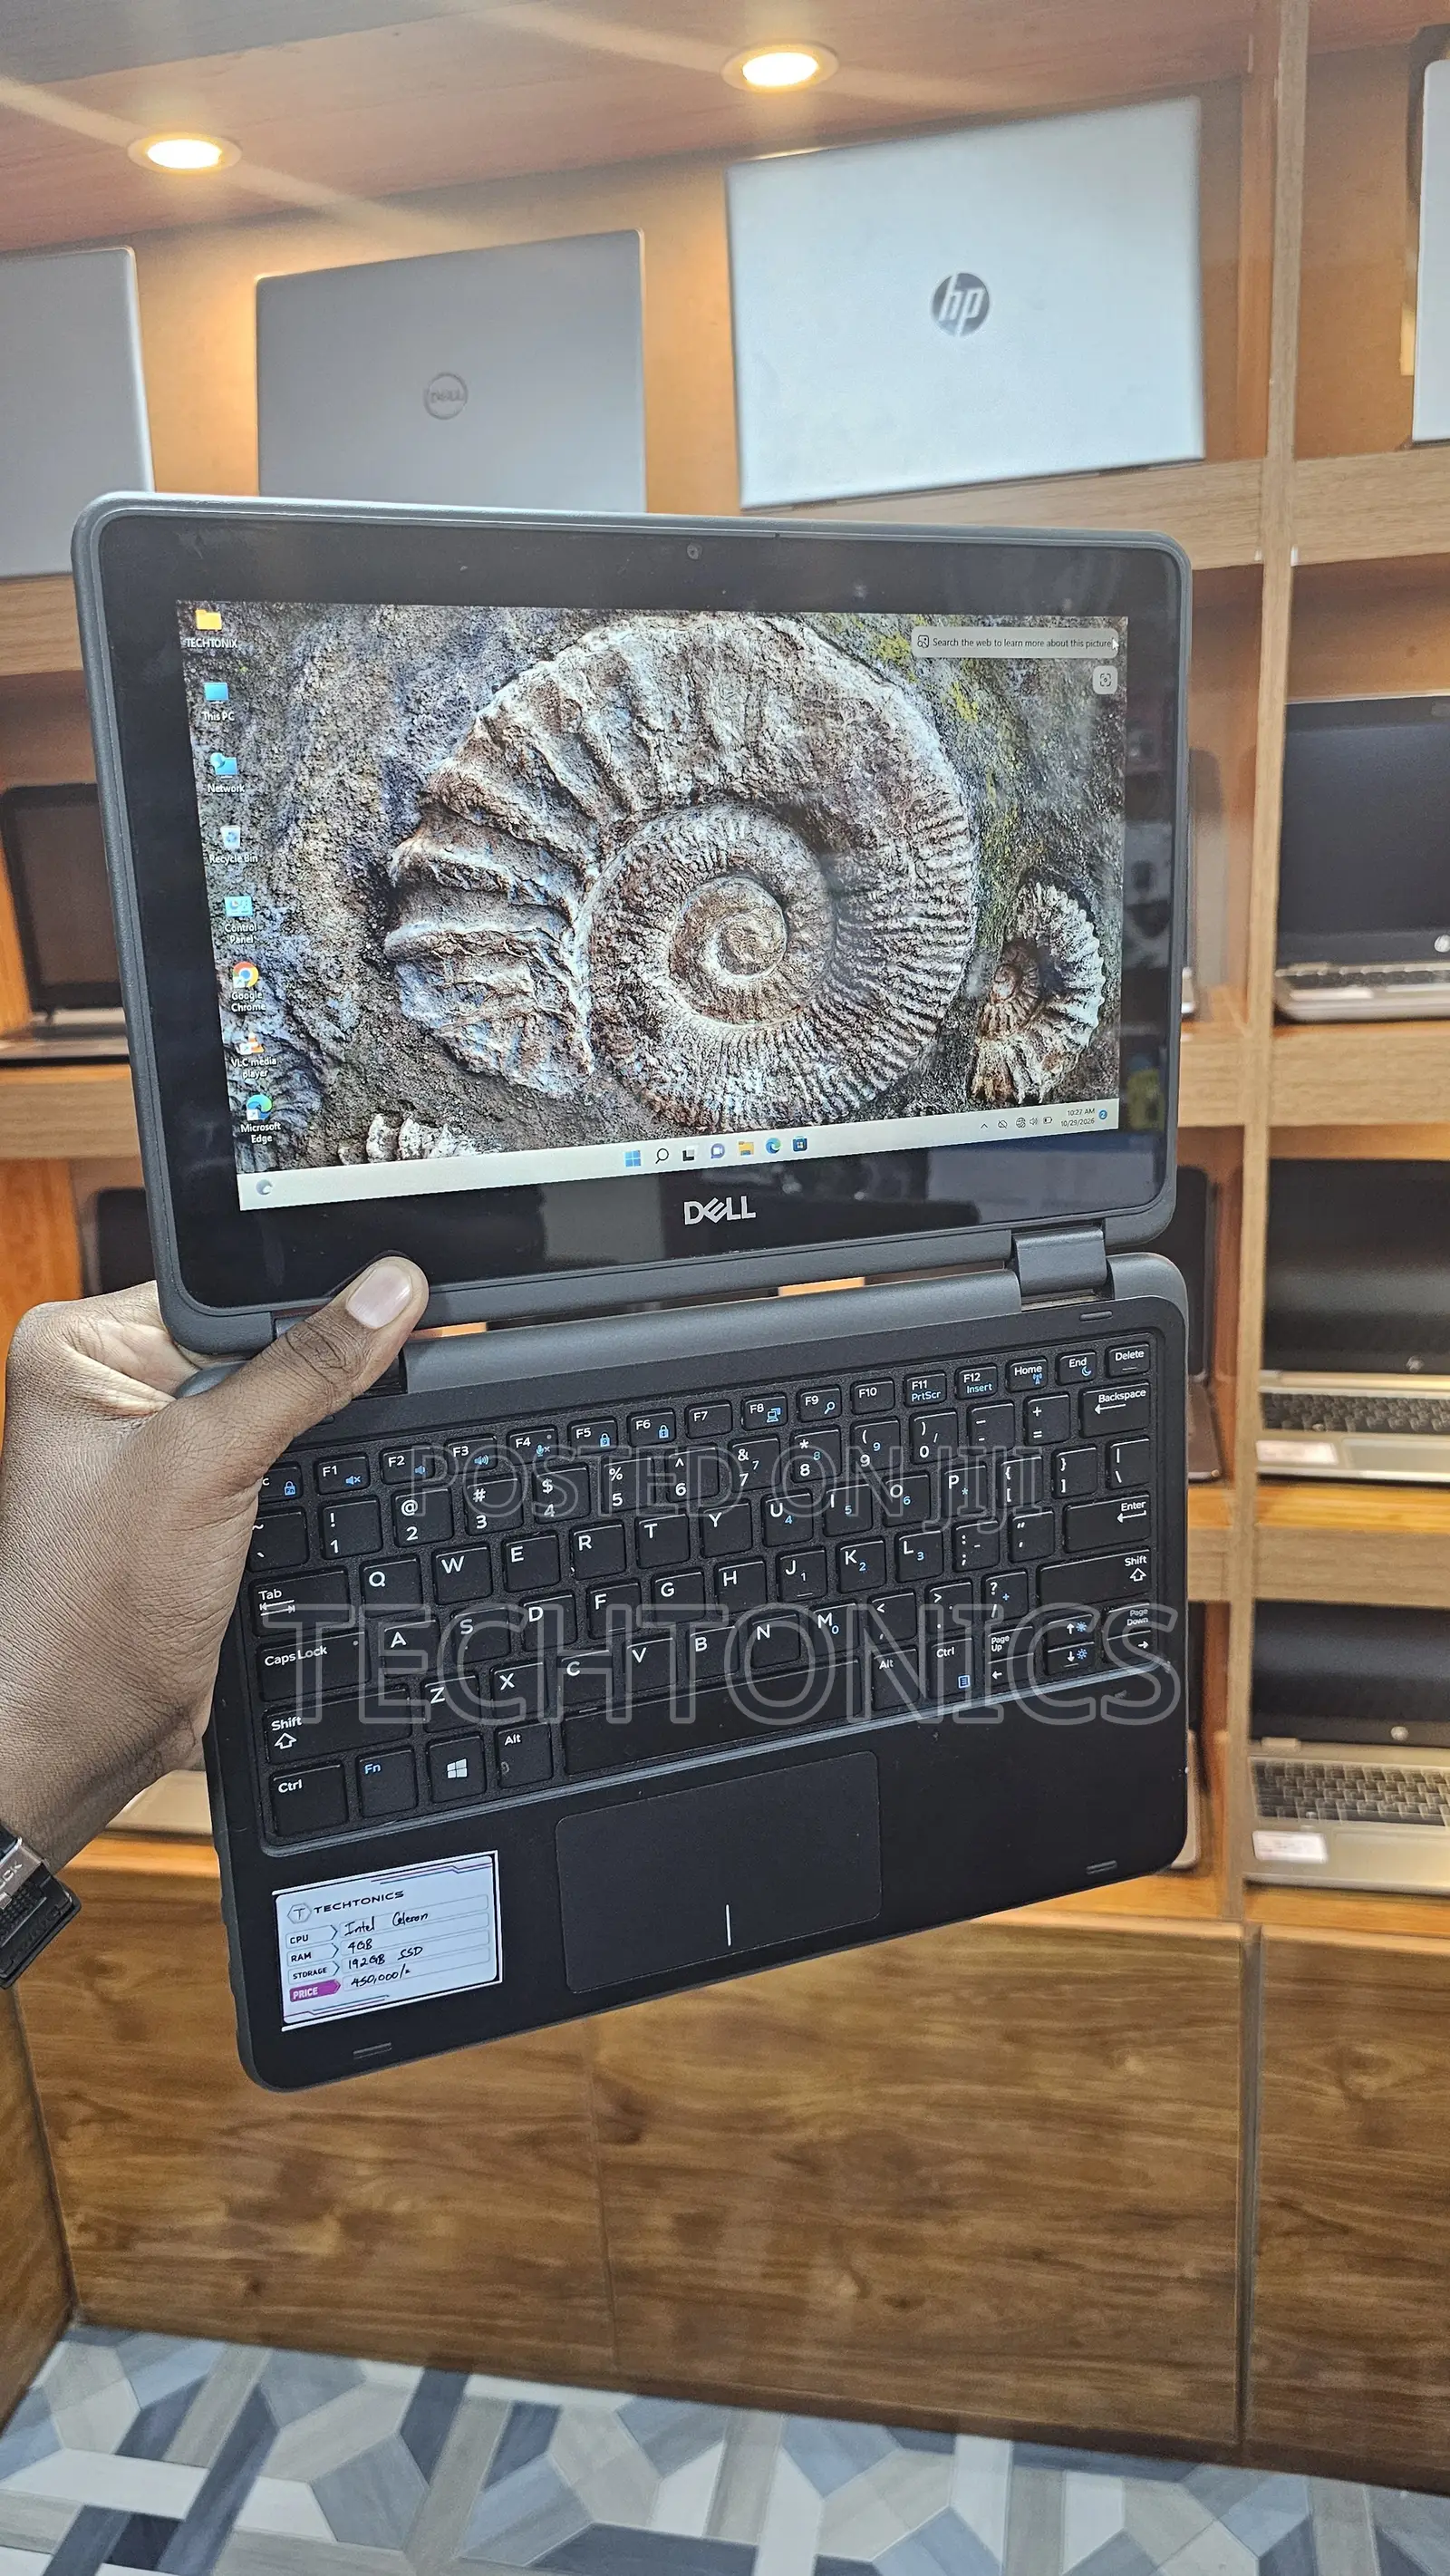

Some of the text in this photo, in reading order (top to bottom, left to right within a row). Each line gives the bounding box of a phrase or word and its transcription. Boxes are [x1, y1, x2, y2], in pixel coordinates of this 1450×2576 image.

[936, 273, 986, 336] hp
[185, 638, 238, 649] TECHTONIX
[933, 638, 959, 647] Search
[962, 638, 974, 647] the
[976, 638, 991, 647] web
[994, 639, 1002, 647] to
[1004, 638, 1023, 647] learn
[1047, 638, 1068, 648] about
[1070, 639, 1084, 648] this
[1086, 639, 1112, 650] picture
[203, 712, 235, 721] This PC
[208, 783, 245, 793] Network
[208, 854, 258, 864] Recycle Bin
[225, 923, 257, 934] Control
[229, 935, 254, 944] Panel
[231, 992, 262, 1002] Google
[231, 1002, 266, 1012] Chrome
[231, 1057, 276, 1067] VLC media
[243, 1069, 268, 1079] player
[240, 1122, 281, 1133] Microsoft
[251, 1134, 272, 1144] Edge
[684, 1196, 756, 1225] DELL
[1115, 1350, 1145, 1361] Delete
[1068, 1357, 1088, 1368] End
[1014, 1364, 1042, 1376] Home
[963, 1372, 981, 1383] F12
[912, 1380, 928, 1390] F11
[966, 1383, 992, 1394] Insert
[858, 1387, 877, 1399] F10
[911, 1390, 941, 1402] PrtScr
[1097, 1389, 1146, 1403] Backspace
[805, 1395, 818, 1406] F9
[749, 1403, 764, 1414] F8
[693, 1411, 708, 1421] F7
[635, 1419, 651, 1430] F6
[575, 1428, 591, 1438] F5
[516, 1437, 531, 1448] F4
[873, 1442, 881, 1451] 9
[453, 1446, 469, 1457] F3
[737, 1449, 749, 1461] &
[813, 1451, 820, 1460] 8
[388, 1455, 405, 1467] F2
[752, 1460, 759, 1470] 7
[860, 1455, 870, 1467] 9
[323, 1466, 337, 1477] F1
[609, 1467, 624, 1481] %
[799, 1464, 810, 1477] 8
[542, 1478, 554, 1494] $
[739, 1473, 749, 1487] 7
[948, 1475, 959, 1489] P
[472, 1487, 486, 1502] #
[675, 1483, 687, 1496] 6
[890, 1484, 904, 1498] O
[612, 1493, 624, 1506] 5
[903, 1496, 911, 1506] 6
[1121, 1500, 1146, 1512] Enter
[401, 1499, 418, 1516] @
[544, 1503, 556, 1517] 4
[770, 1502, 783, 1517] U
[845, 1506, 852, 1515] 5
[476, 1515, 488, 1529] 3
[709, 1512, 722, 1528] Y
[785, 1515, 793, 1525] 4
[406, 1526, 418, 1541] 2
[644, 1523, 657, 1539] T
[330, 1540, 339, 1554] 1
[578, 1535, 593, 1551] R
[904, 1540, 914, 1554] L
[510, 1545, 525, 1563] E
[845, 1549, 857, 1565] K
[917, 1552, 924, 1561] 3
[1124, 1554, 1147, 1567] Shift
[441, 1555, 464, 1574] W
[785, 1560, 796, 1575] J
[859, 1562, 866, 1572] 2
[369, 1571, 386, 1587] Q
[723, 1570, 737, 1586] H
[800, 1573, 807, 1582] 1
[258, 1589, 282, 1601] Tab
[661, 1583, 675, 1597] G
[990, 1582, 998, 1595] ?
[594, 1593, 607, 1610] F
[528, 1606, 544, 1622] D
[1129, 1608, 1148, 1617] Page
[459, 1619, 473, 1635] S
[817, 1612, 832, 1629] M
[1126, 1616, 1148, 1626] Down
[756, 1624, 770, 1640] N
[390, 1632, 407, 1648] A
[695, 1637, 708, 1652] B
[991, 1635, 1010, 1645] Page
[632, 1647, 647, 1663] V
[936, 1646, 955, 1658] Ctrl
[991, 1644, 1003, 1653] Up
[265, 1645, 328, 1667] Caps Lock
[566, 1661, 581, 1676] C
[879, 1659, 894, 1670] Alt
[499, 1672, 516, 1690] X
[430, 1687, 446, 1704] Z
[271, 1716, 302, 1731] Shift
[504, 1733, 522, 1746] Alt
[364, 1763, 382, 1775] Fn
[277, 1779, 303, 1793] Ctrl
[314, 1890, 405, 1914] TECHTONICS
[290, 1934, 309, 1944] CPU
[344, 1916, 376, 1936] Intel
[291, 1938, 373, 1962] RAM 4GB
[293, 1946, 423, 1980] STORAGE 192GB SSD
[293, 1987, 319, 2000] PRICE
